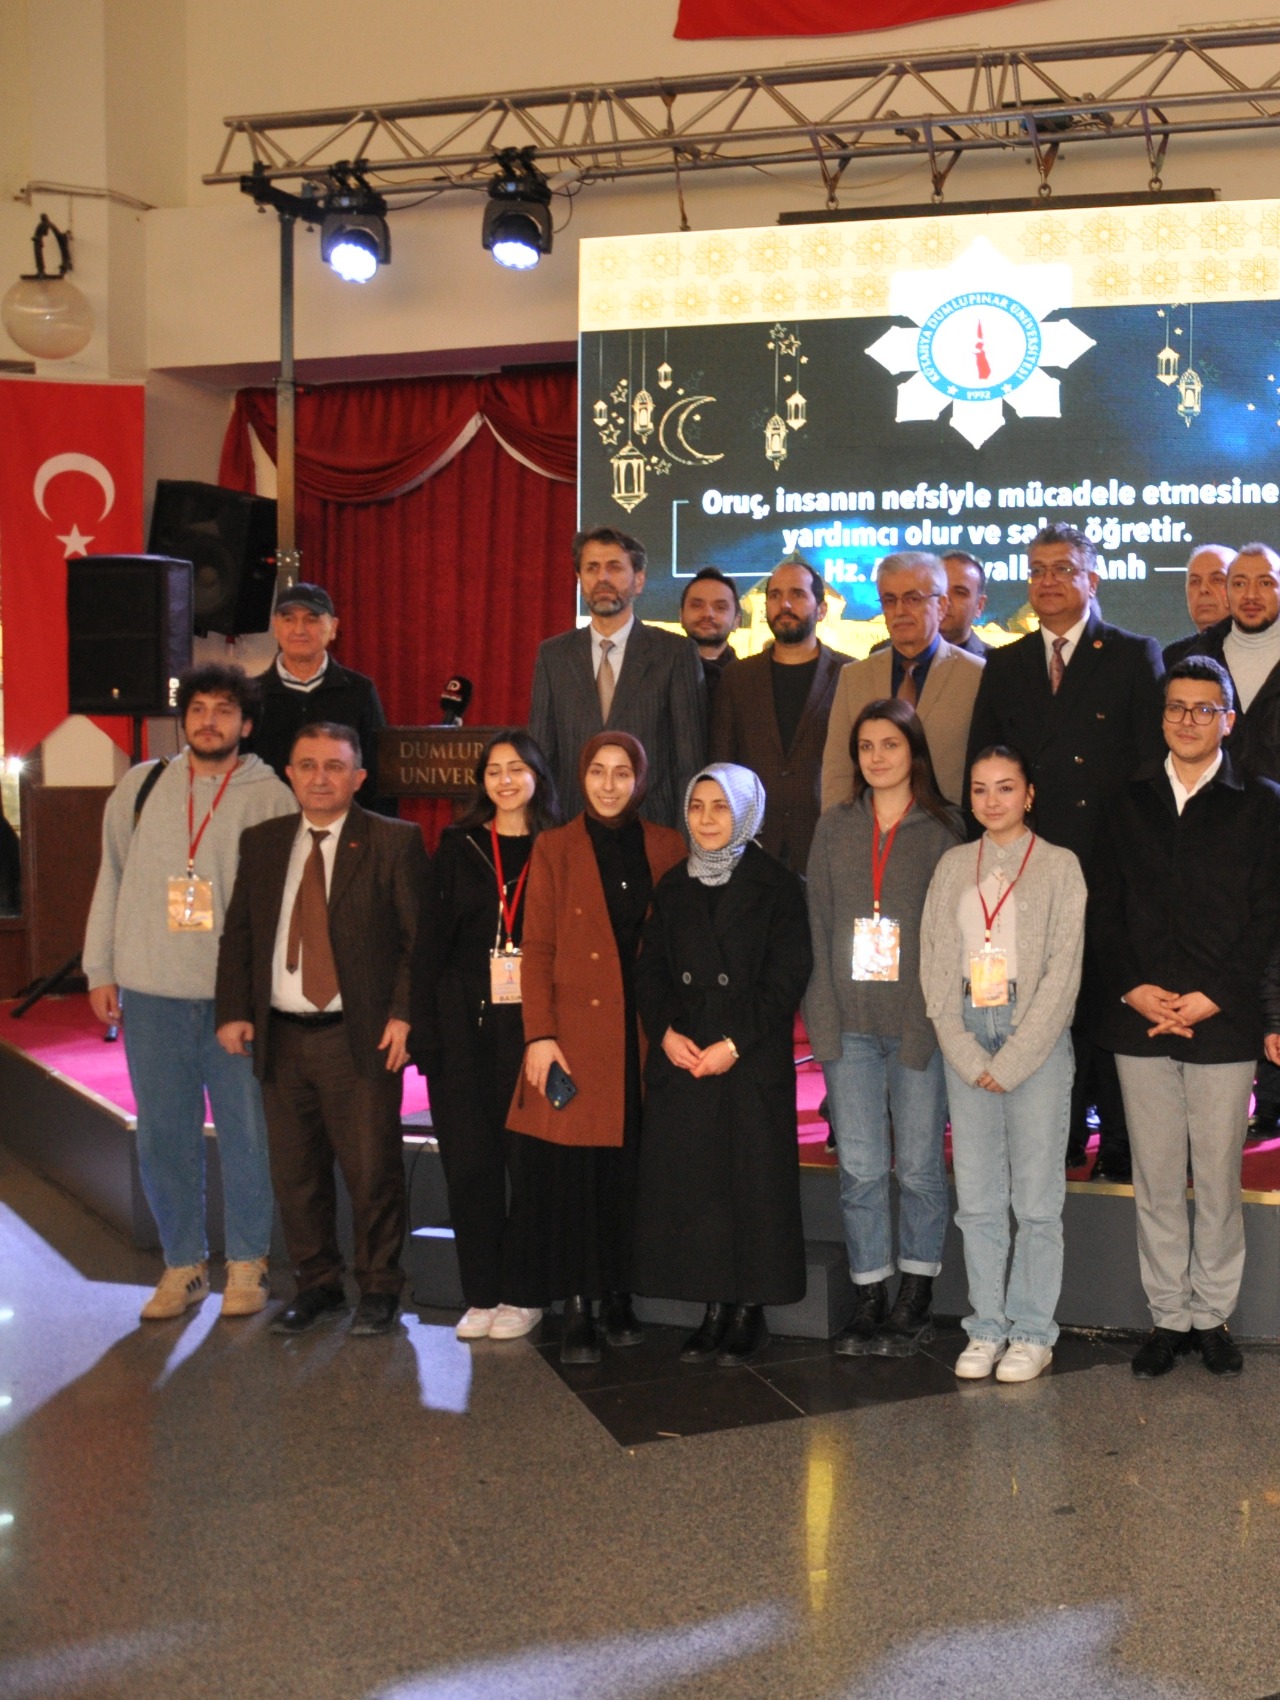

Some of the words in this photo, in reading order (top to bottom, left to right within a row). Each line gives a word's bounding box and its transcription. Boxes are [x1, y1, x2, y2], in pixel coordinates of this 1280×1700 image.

[926, 293, 1009, 329] DUMLUPINAR
[966, 390, 992, 400] 1992
[702, 489, 770, 520] Oruç,
[775, 486, 875, 513] insanın
[881, 481, 992, 516] nefsiyle
[998, 478, 1136, 508] mücadele
[1142, 476, 1280, 506] etmesine
[781, 520, 898, 555] yardımcı
[904, 518, 963, 546] olur
[966, 523, 1001, 545] ve
[1084, 515, 1193, 551] öğretir.
[823, 558, 867, 583] Hz.
[400, 741, 484, 760] DUMLUP
[400, 766, 478, 785] UNIVER
